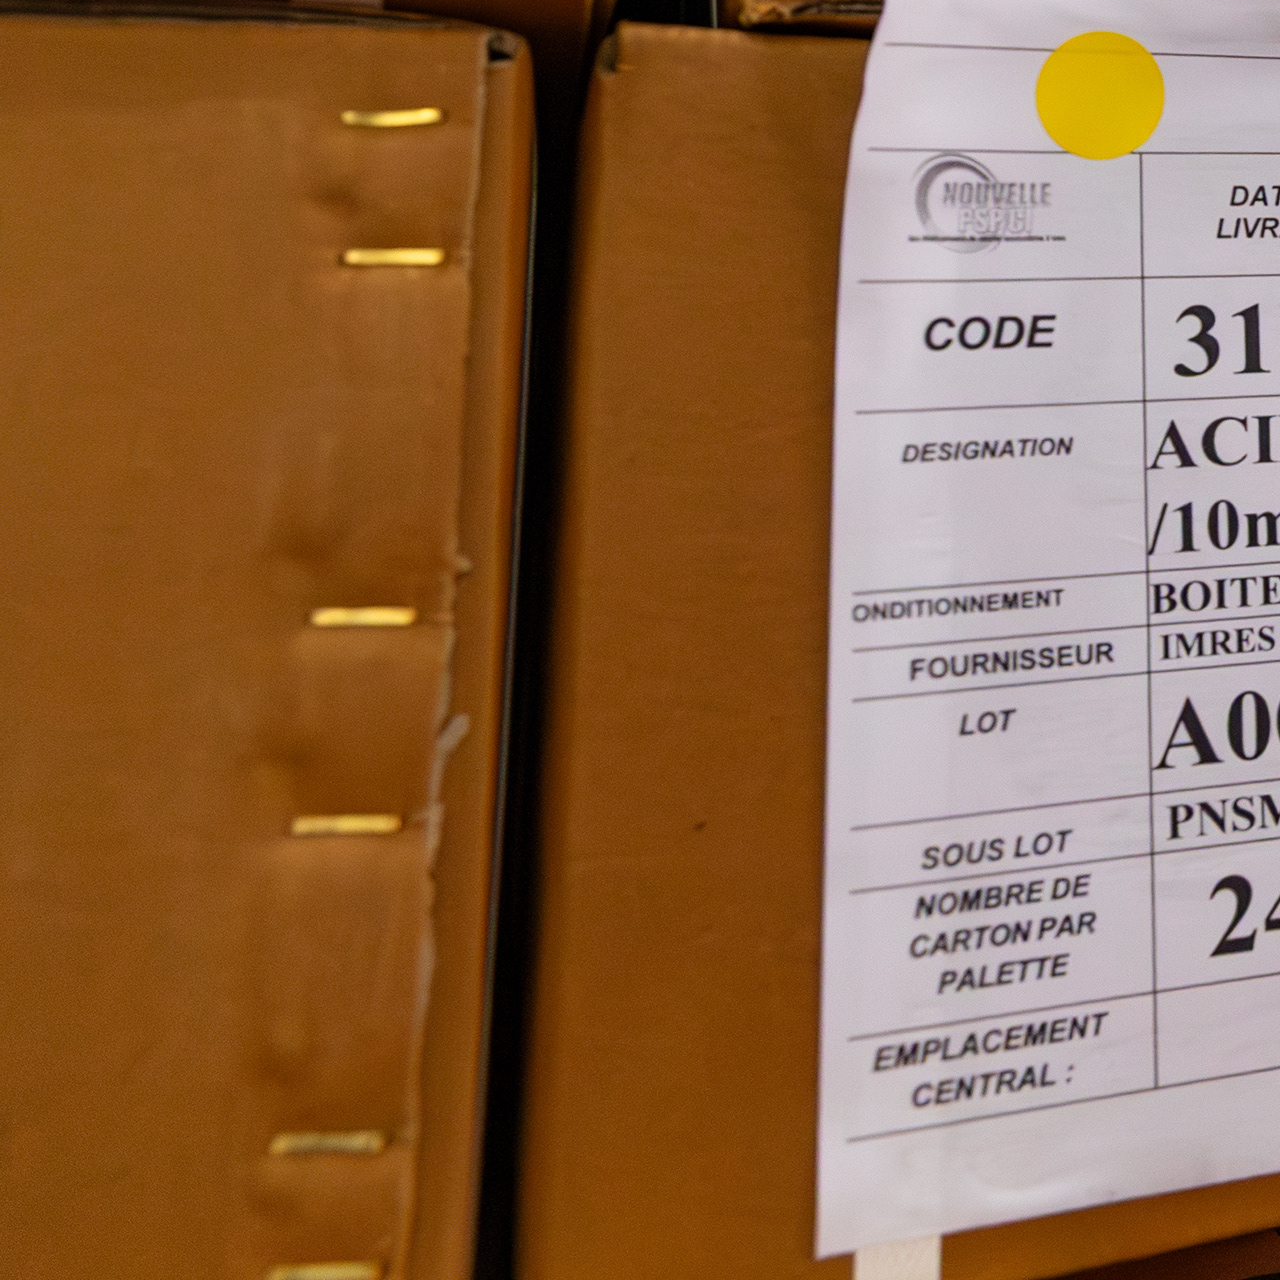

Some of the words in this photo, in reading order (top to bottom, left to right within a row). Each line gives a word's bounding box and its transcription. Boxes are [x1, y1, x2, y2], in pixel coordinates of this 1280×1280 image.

[923, 314, 1057, 351] CODE
[901, 435, 1075, 464] DESIGNATION
[852, 588, 1066, 623] ONDITIONNEMENT
[909, 641, 1115, 681] FOURNISSEUR
[1158, 625, 1277, 662] IMRES
[959, 708, 1017, 737] LOT
[921, 839, 1006, 871] SOUS
[1013, 829, 1073, 859] LOT
[914, 880, 1045, 920] NOMBRE
[1050, 874, 1092, 901] DE
[909, 918, 1033, 960] CARTON
[1036, 911, 1098, 940] PAR
[937, 954, 1071, 995] PALETTE
[872, 1011, 1109, 1074] EMPLACEMENT
[911, 1064, 1058, 1110] CENTRAL
